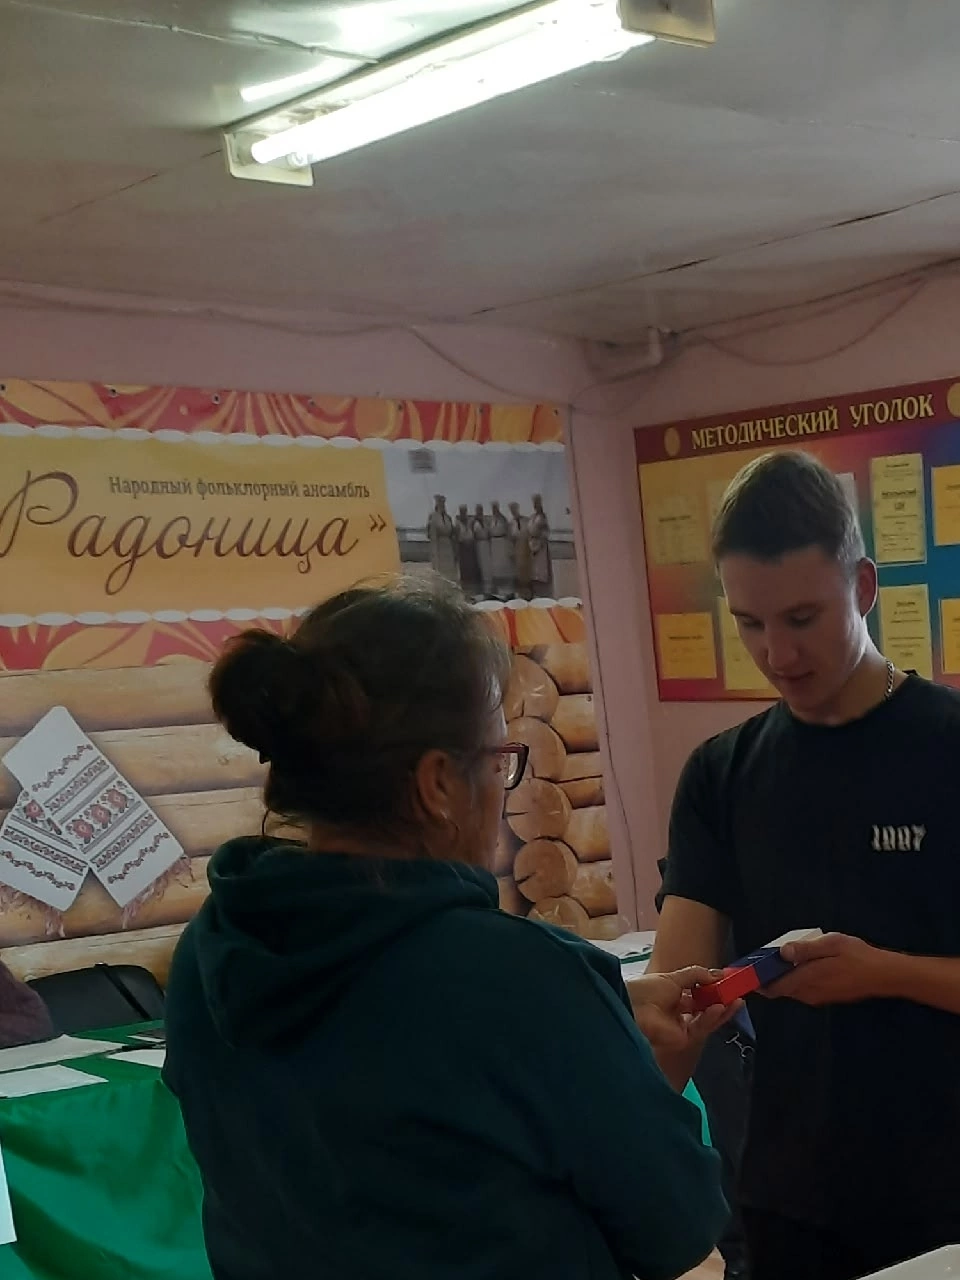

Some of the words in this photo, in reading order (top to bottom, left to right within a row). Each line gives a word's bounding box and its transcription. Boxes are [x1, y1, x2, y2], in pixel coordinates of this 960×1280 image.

[691, 405, 839, 450] МЕТОДИЧЕСКИЙ
[849, 393, 935, 428] УГОЛОК
[108, 476, 192, 499] Народный
[198, 477, 300, 500] фольклорный
[302, 483, 370, 499] ансамбль
